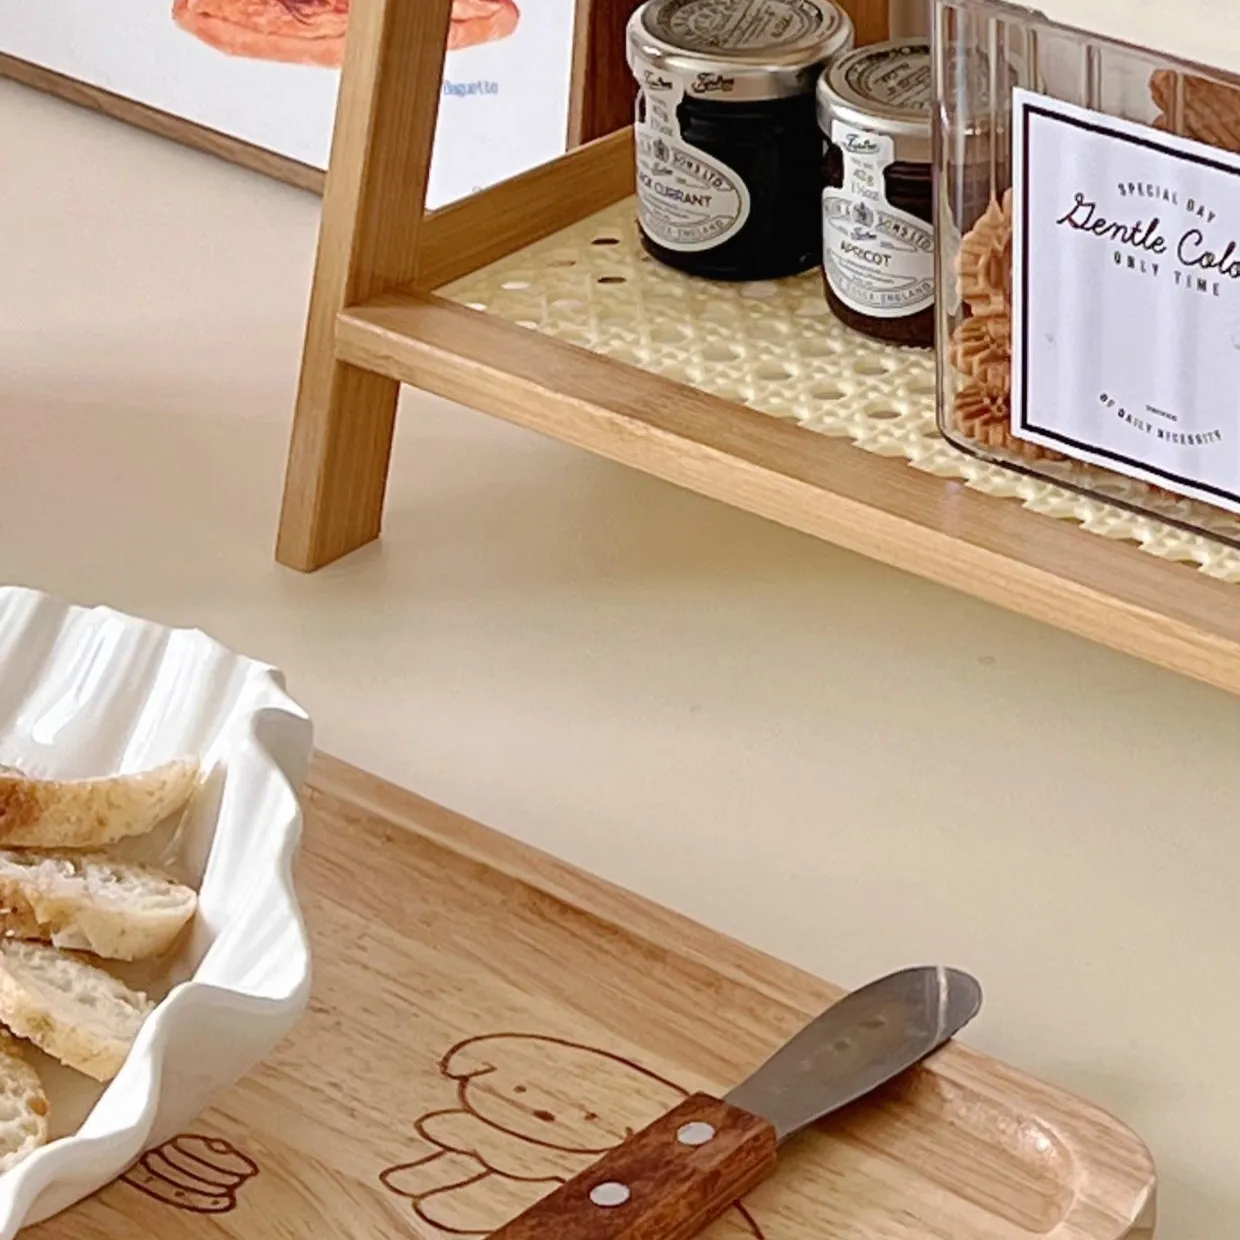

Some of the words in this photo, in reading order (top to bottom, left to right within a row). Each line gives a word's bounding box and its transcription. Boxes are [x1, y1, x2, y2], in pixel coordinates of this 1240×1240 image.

[654, 182, 713, 206] CURRANT
[1117, 182, 1178, 206] SPECIAL
[1186, 198, 1217, 223] DAY
[1056, 192, 1167, 254] Gentle
[1113, 250, 1159, 277] ONLY
[1173, 270, 1220, 297] TIME
[1117, 407, 1152, 434] DAILY
[1156, 427, 1222, 446] NECESSITY
